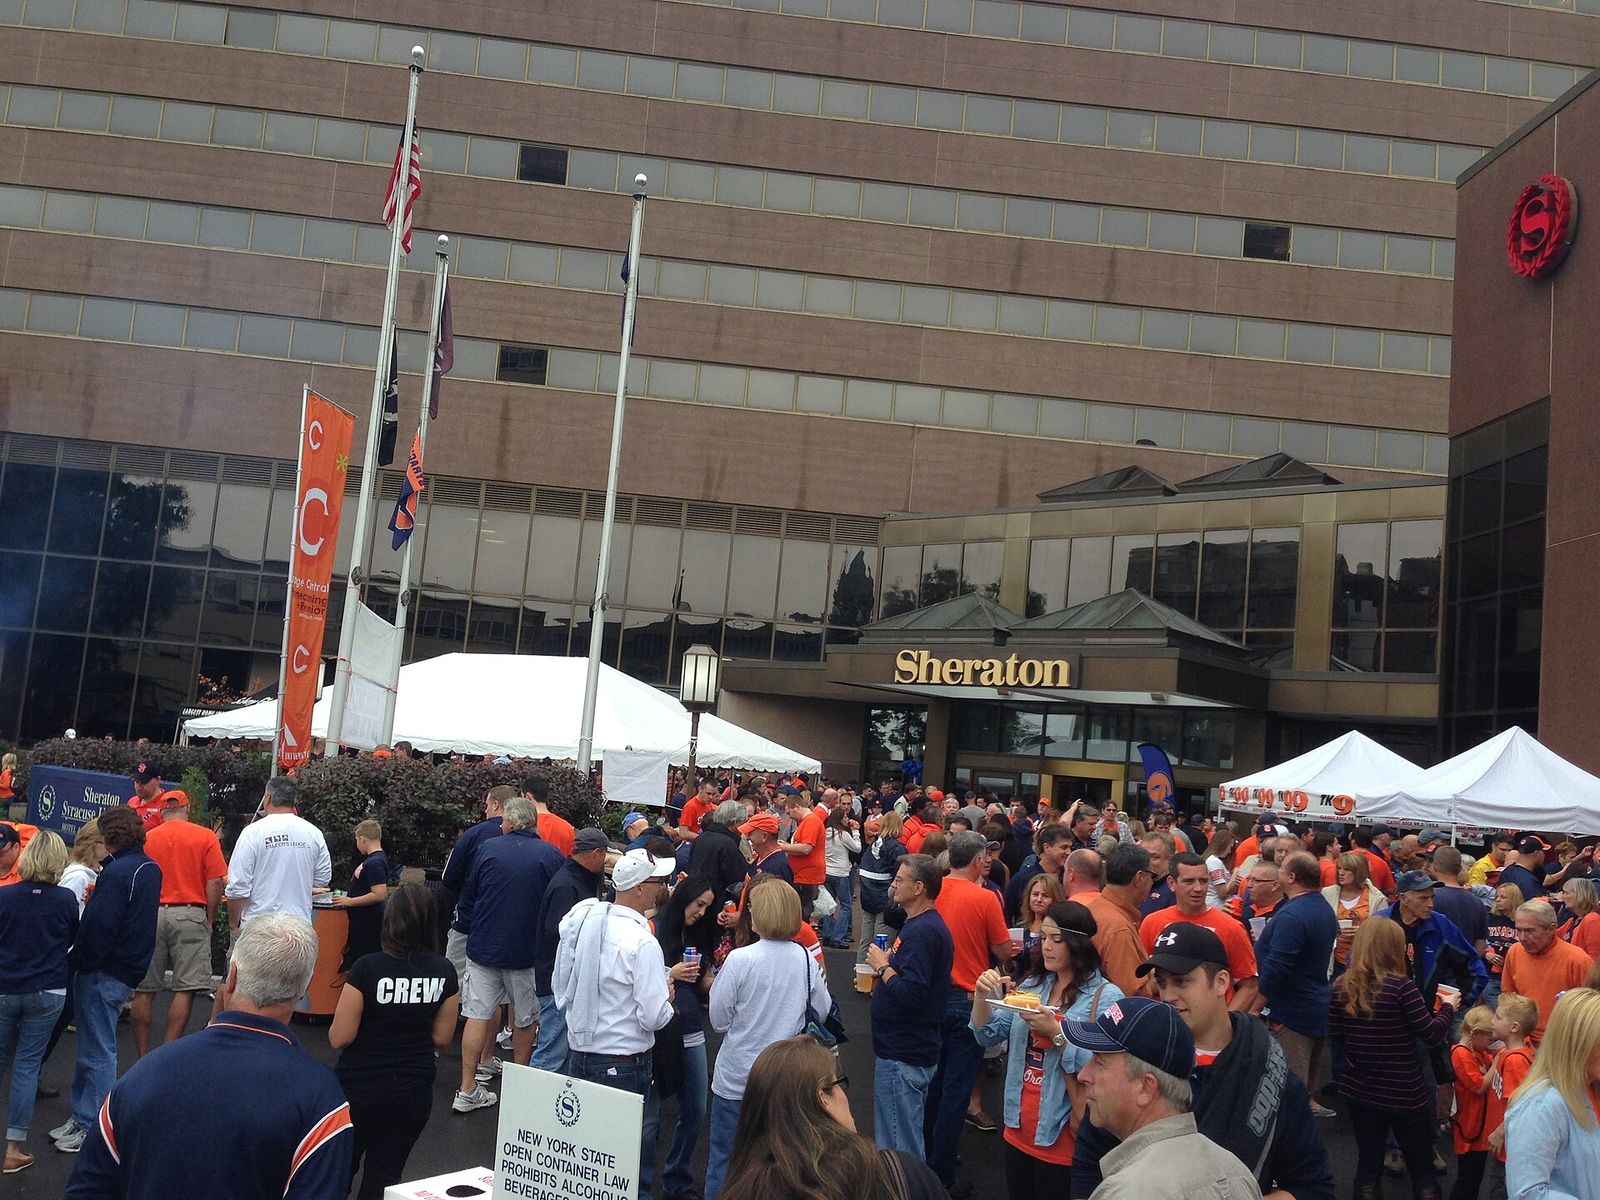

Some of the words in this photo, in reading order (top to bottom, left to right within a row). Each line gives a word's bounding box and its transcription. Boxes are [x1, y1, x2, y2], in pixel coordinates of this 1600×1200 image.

[894, 649, 1072, 688] Sheraton
[83, 786, 121, 807] Sheraton
[1320, 794, 1356, 816] TK9
[61, 801, 96, 821] Syracuse
[376, 977, 446, 1005] CREW
[1023, 1069, 1044, 1086] Ora
[560, 1096, 575, 1119] S
[517, 1128, 543, 1148] NEW
[546, 1136, 577, 1158] YORK
[580, 1147, 616, 1169] STATE
[501, 1159, 558, 1189] PROHIBITS
[503, 1142, 532, 1163] OPEN
[536, 1152, 600, 1183] CONTAINER
[603, 1172, 630, 1192] LAW
